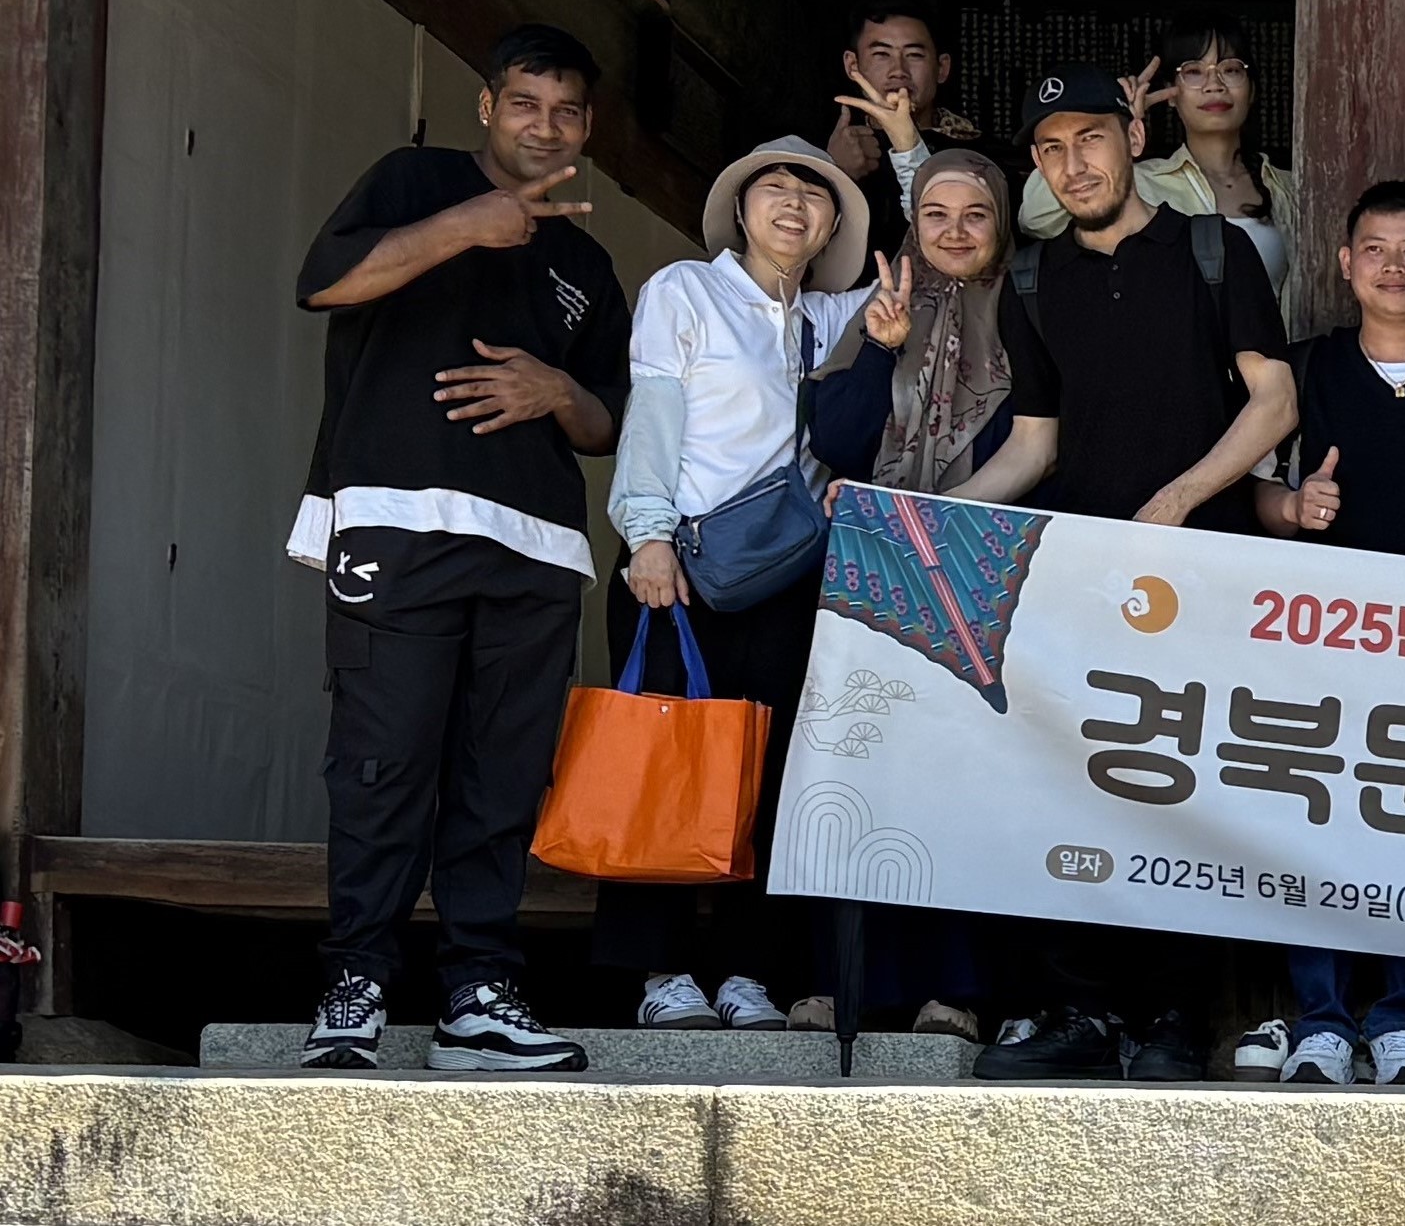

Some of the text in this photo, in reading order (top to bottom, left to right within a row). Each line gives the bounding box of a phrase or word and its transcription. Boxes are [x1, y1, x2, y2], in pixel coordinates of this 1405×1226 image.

[1059, 850, 1103, 878] 일자
[1128, 854, 1245, 899] 2025년
[1257, 873, 1307, 907] 6월
